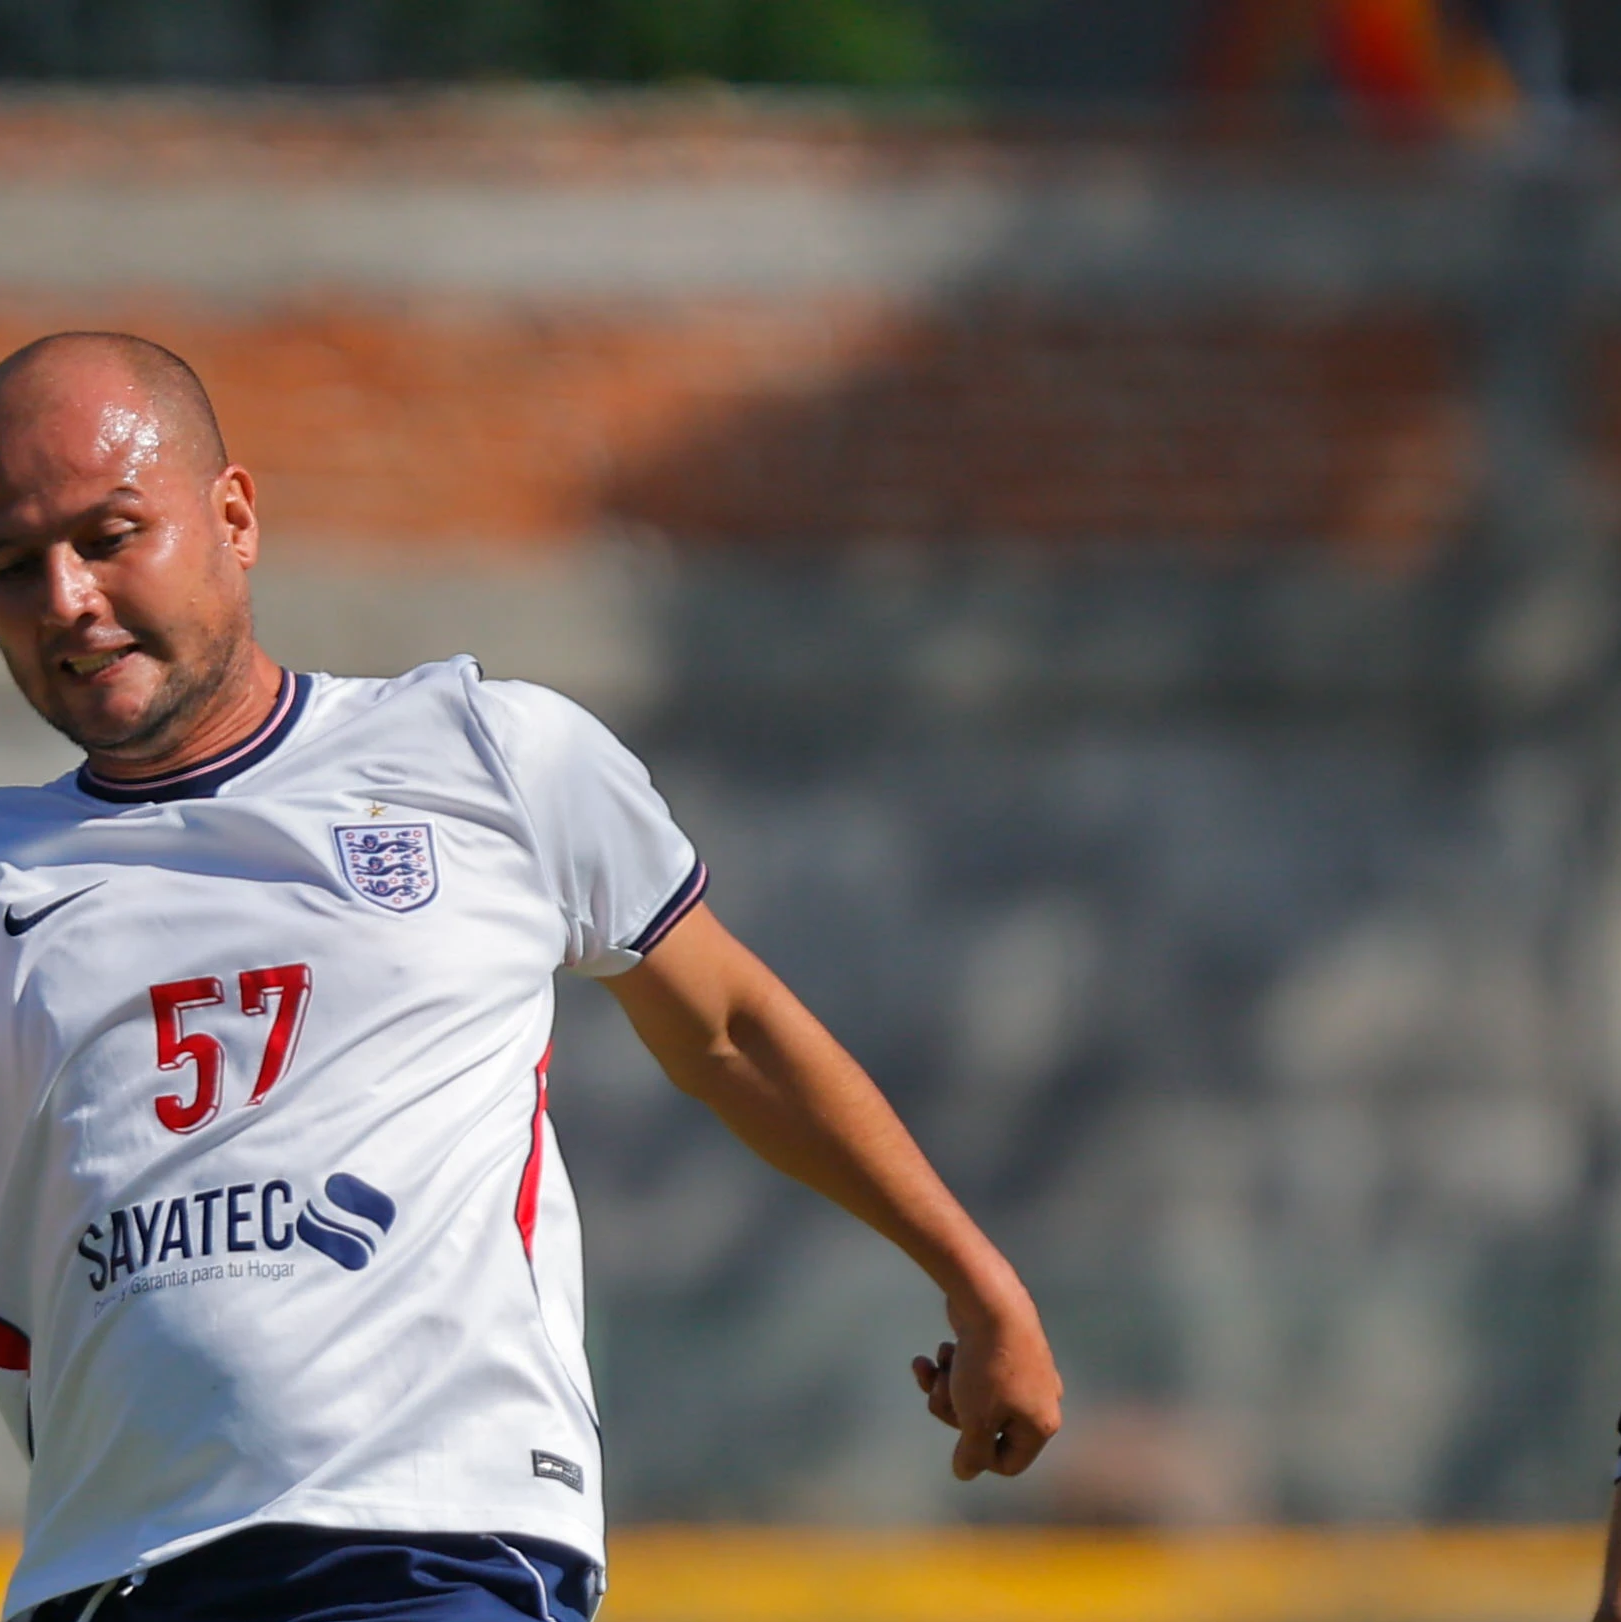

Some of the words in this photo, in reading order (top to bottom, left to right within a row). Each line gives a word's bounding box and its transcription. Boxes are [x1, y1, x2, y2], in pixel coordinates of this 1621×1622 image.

[149, 962, 312, 1135] 57
[77, 1179, 295, 1292] SAYATEC
[191, 1264, 224, 1286] para
[228, 1261, 244, 1278] tu
[247, 1259, 296, 1281] Hogar
